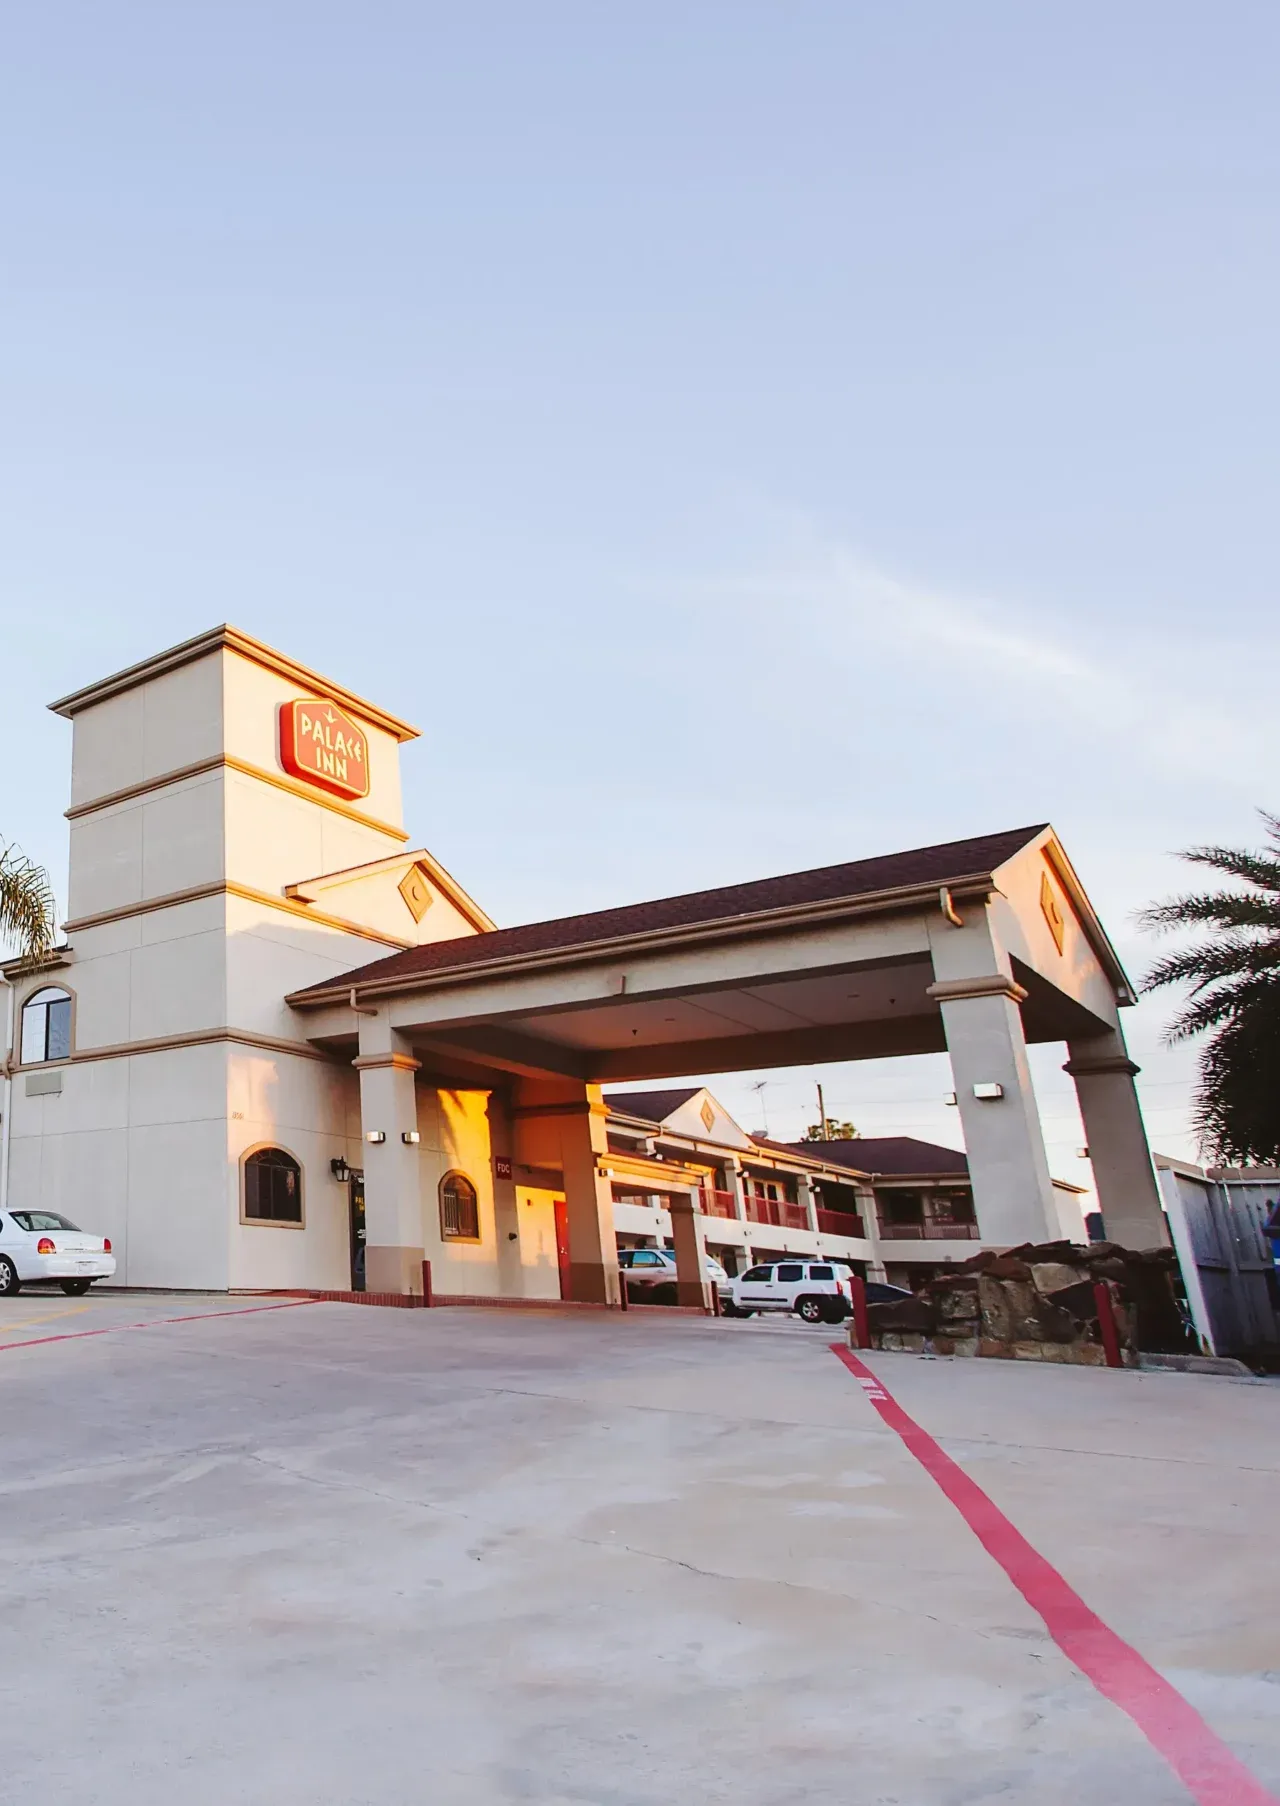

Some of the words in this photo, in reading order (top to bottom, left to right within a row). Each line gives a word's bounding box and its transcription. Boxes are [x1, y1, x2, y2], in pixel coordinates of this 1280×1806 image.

[301, 712, 362, 763] PALACE
[316, 746, 348, 781] INN
[497, 1162, 510, 1174] FDC
